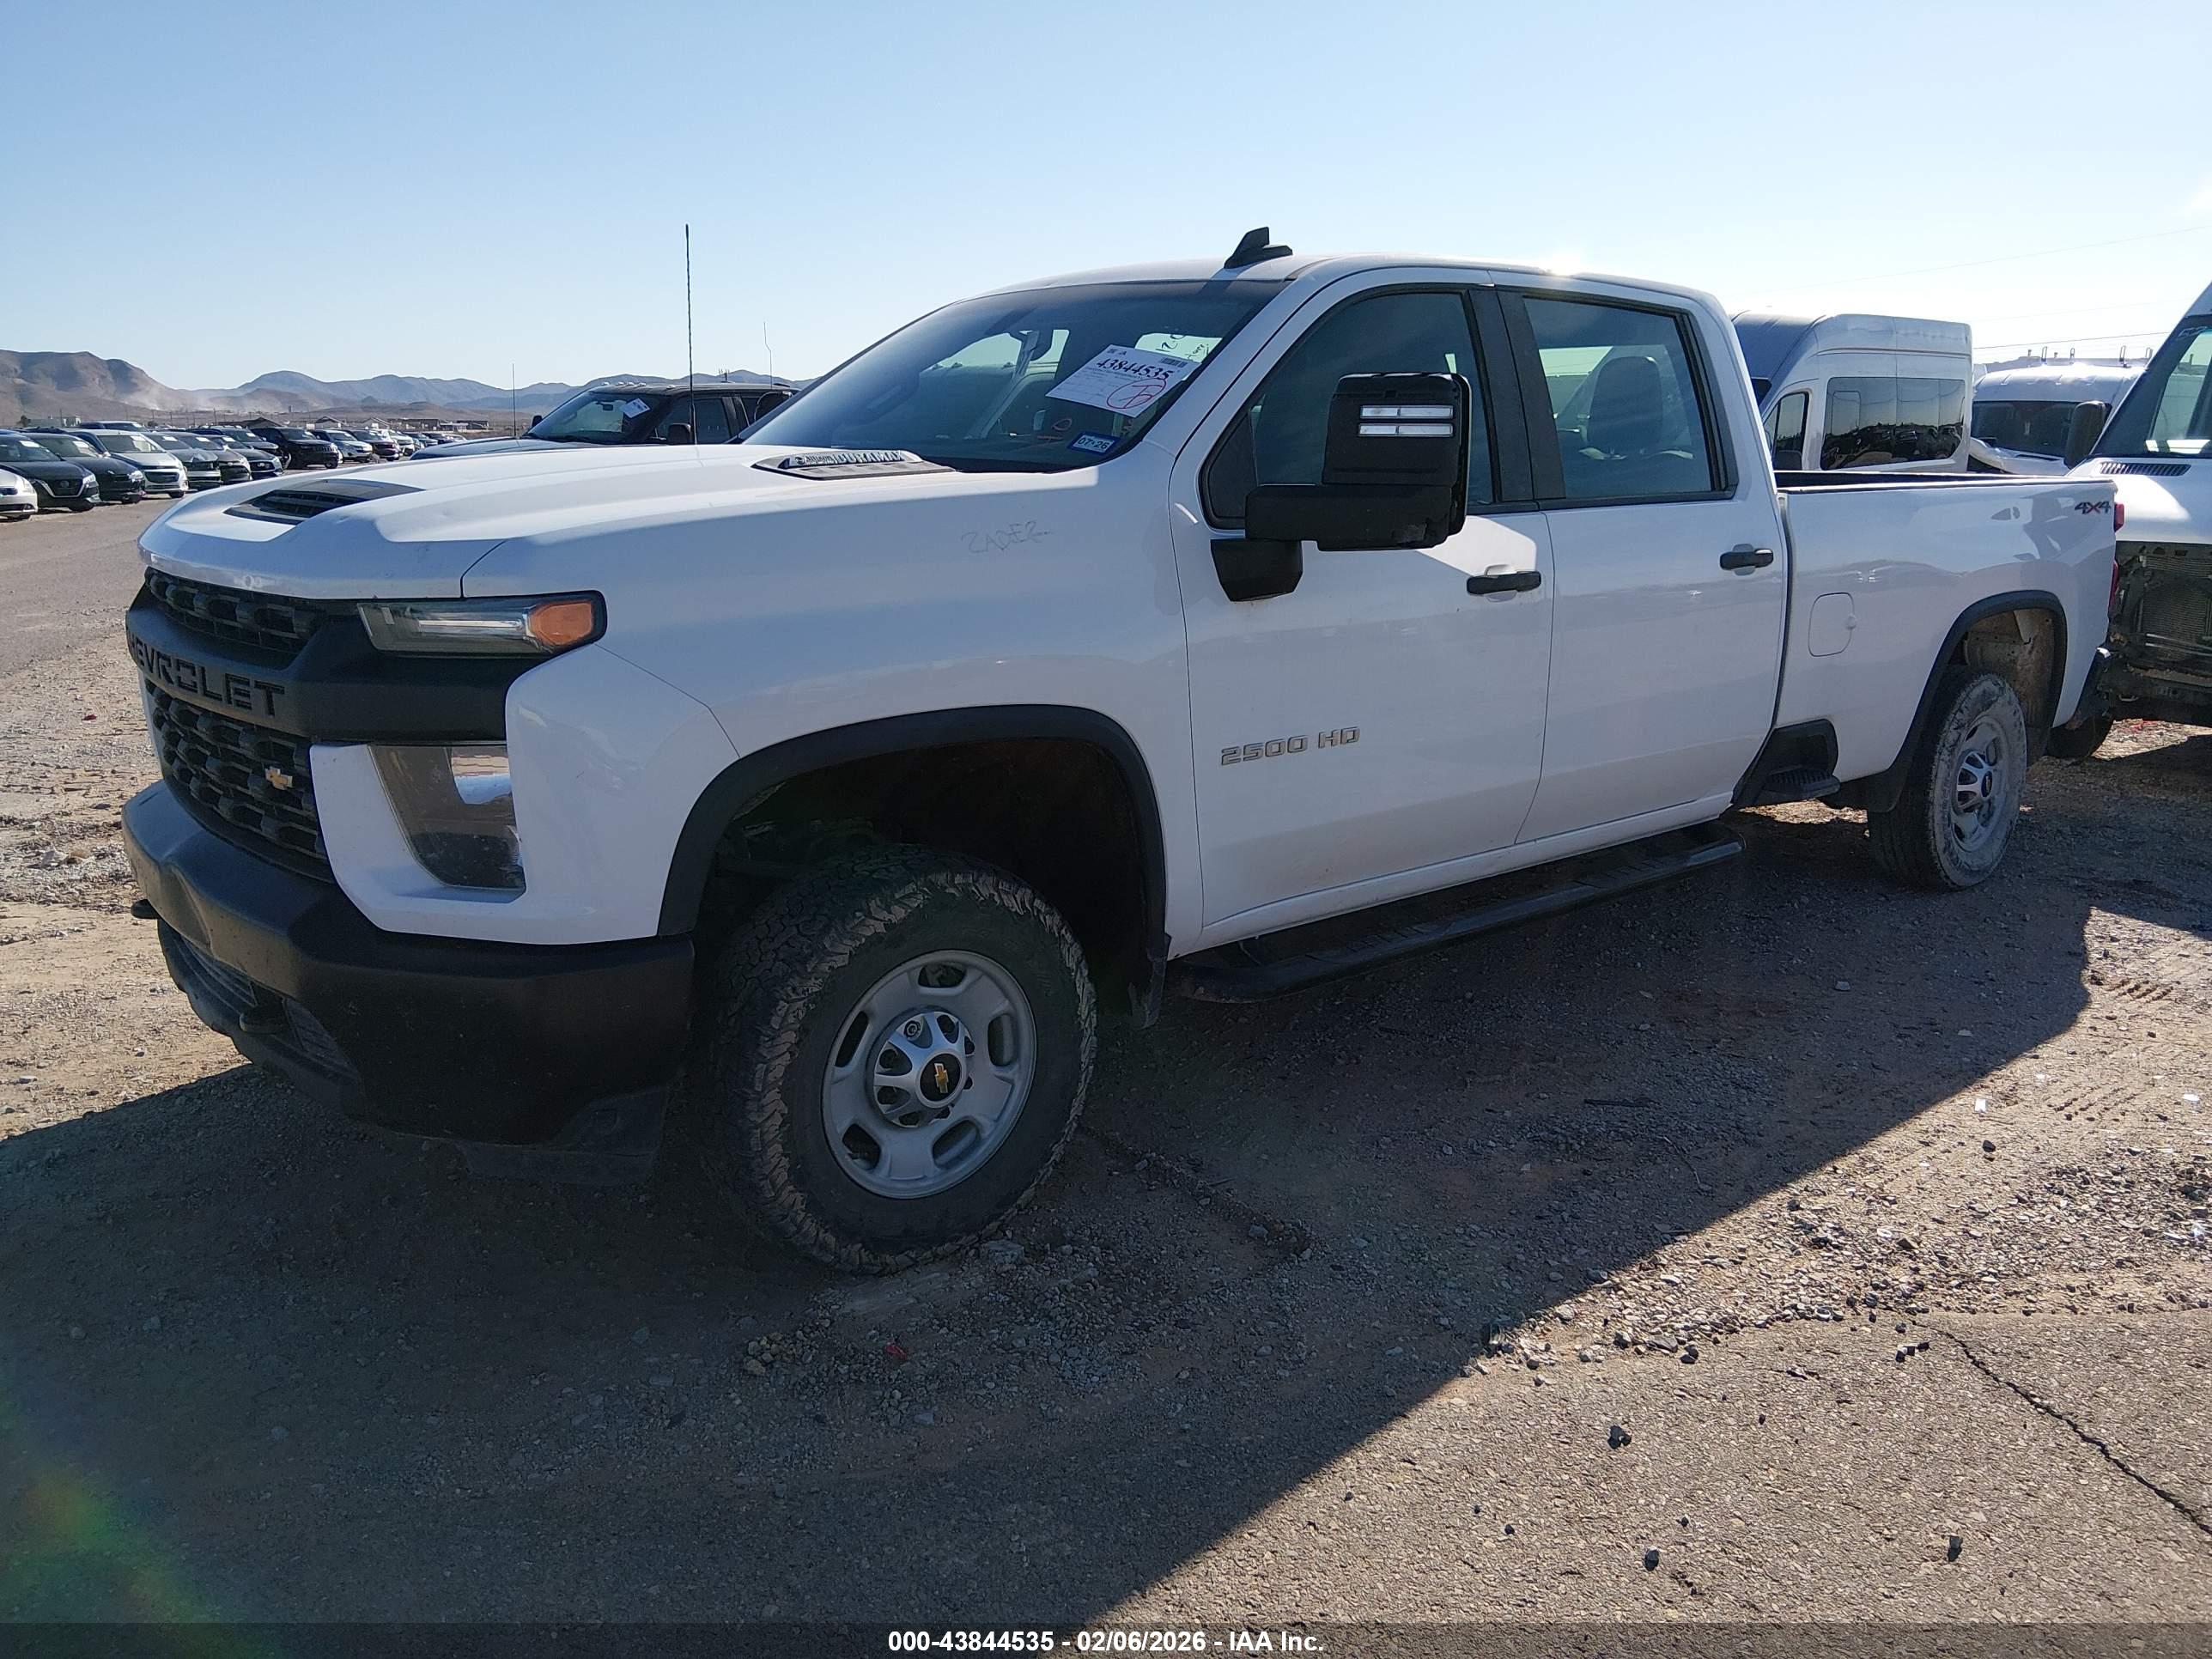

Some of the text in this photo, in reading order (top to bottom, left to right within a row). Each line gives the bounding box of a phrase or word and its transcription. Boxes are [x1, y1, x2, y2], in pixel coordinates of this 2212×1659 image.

[1097, 358, 1174, 380] 43844535
[836, 451, 905, 464] DURAMAX
[1221, 726, 1361, 766] 2500 HD
